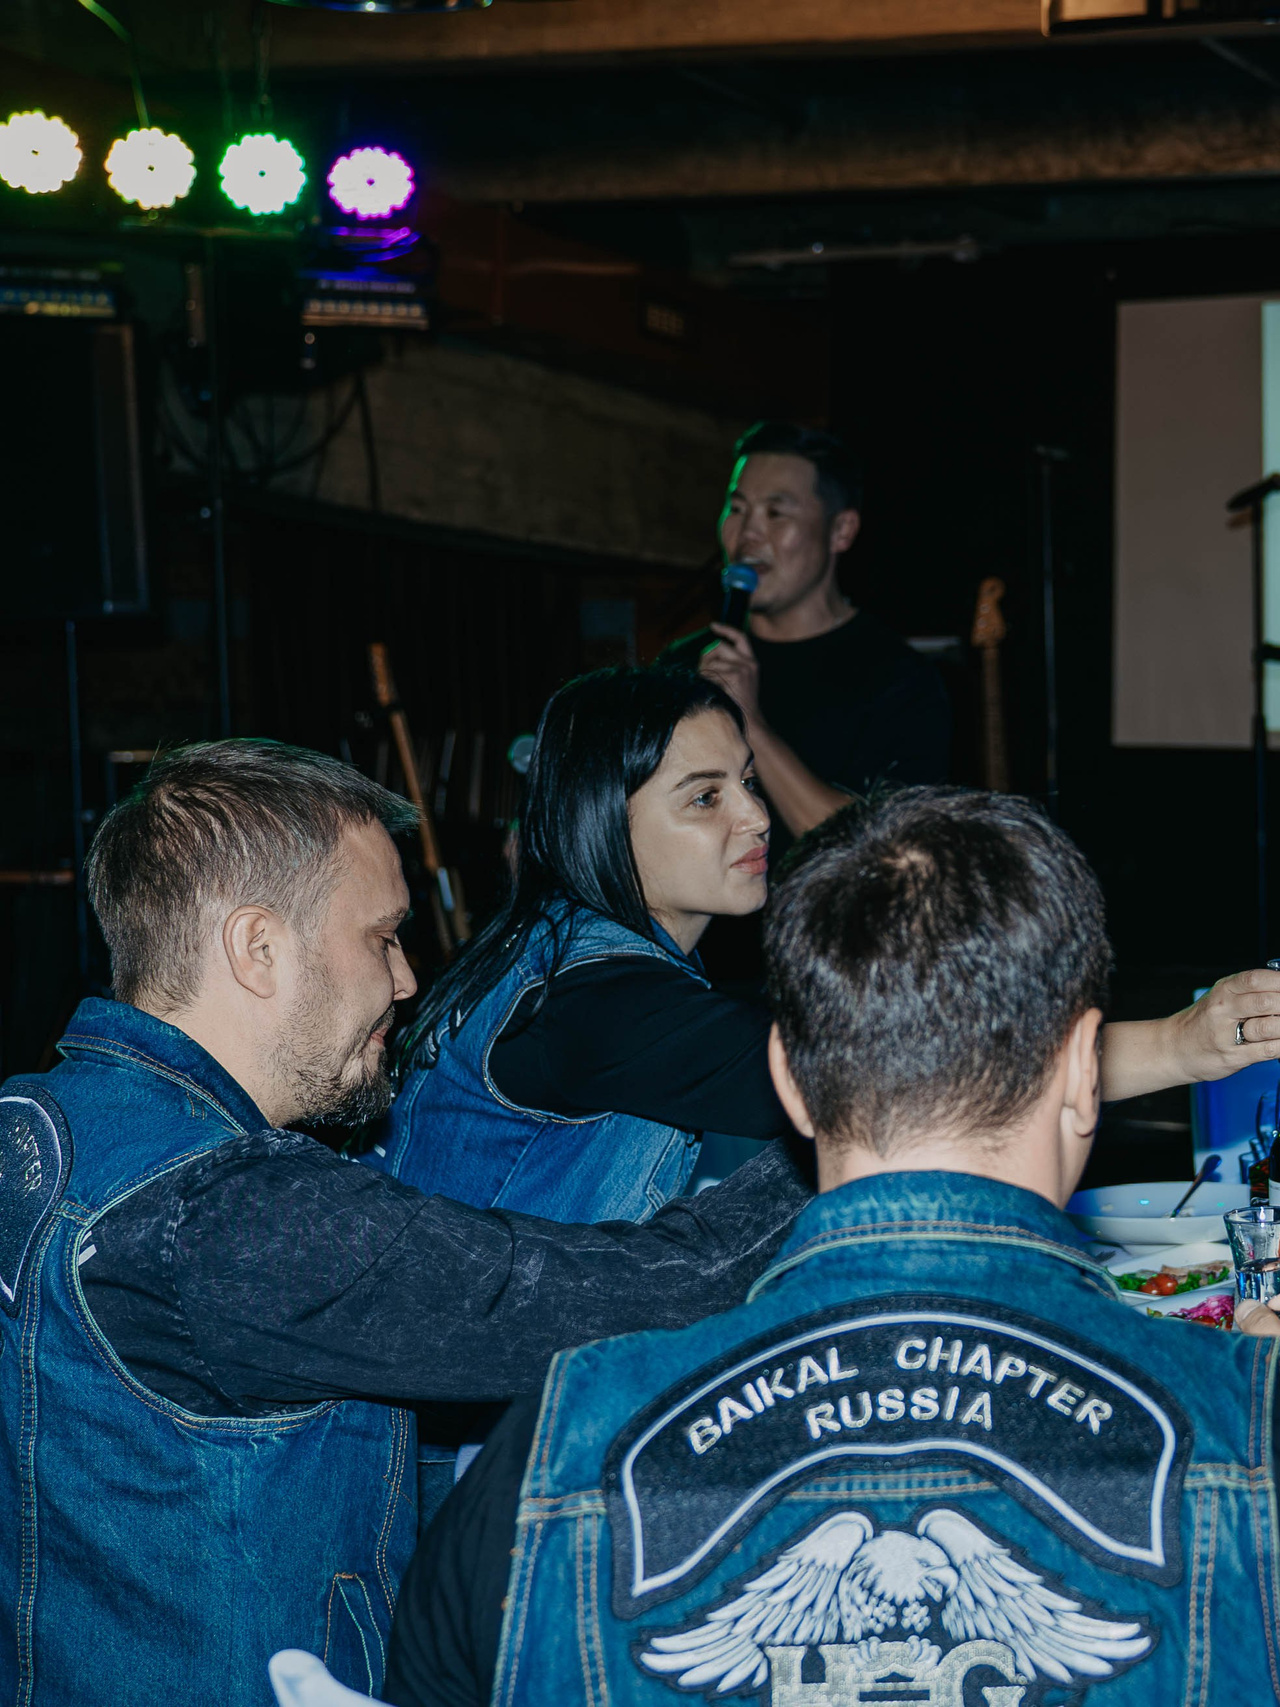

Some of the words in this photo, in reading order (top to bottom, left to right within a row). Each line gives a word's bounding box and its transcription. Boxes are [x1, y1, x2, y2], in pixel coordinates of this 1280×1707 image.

[686, 1346, 859, 1455] BAIKAL
[896, 1335, 1114, 1435] CHAPTER
[806, 1385, 993, 1441] RUSSIA
